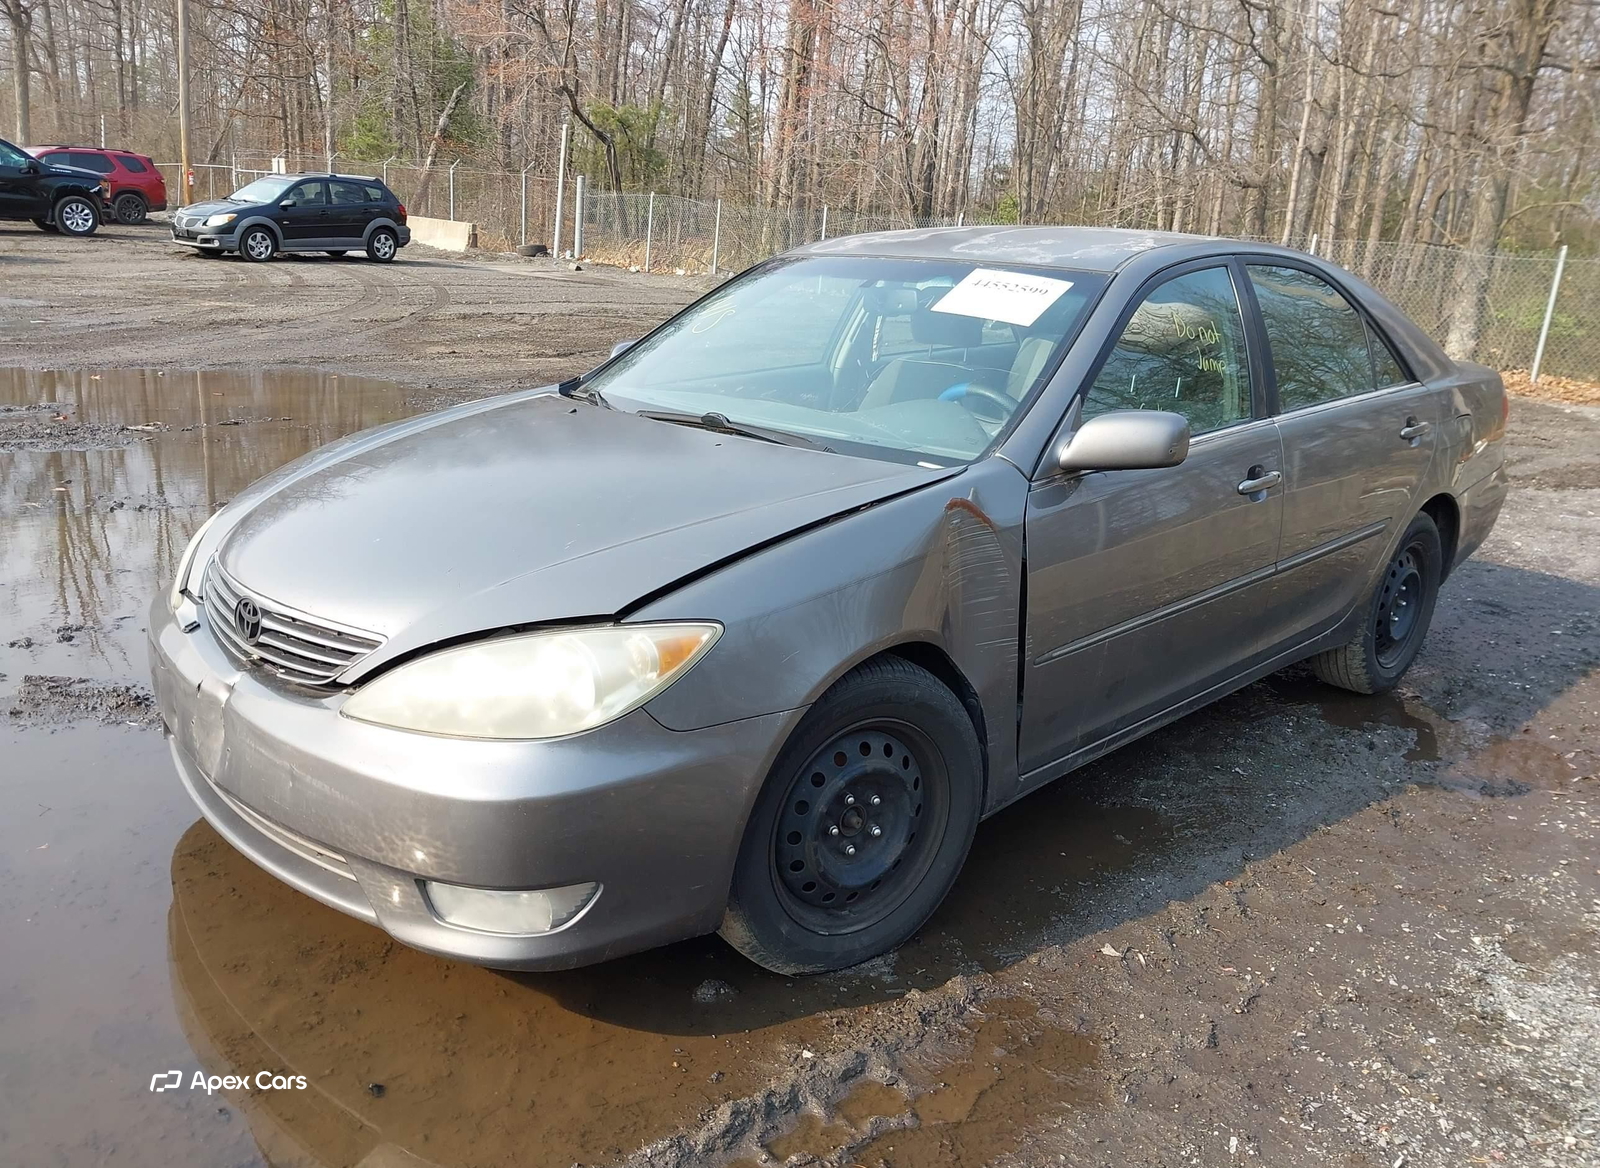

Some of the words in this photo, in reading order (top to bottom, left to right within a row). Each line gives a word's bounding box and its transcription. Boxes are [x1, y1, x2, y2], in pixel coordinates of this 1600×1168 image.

[1171, 310, 1196, 340] Do
[1198, 320, 1222, 345] not
[1196, 345, 1227, 378] Jump
